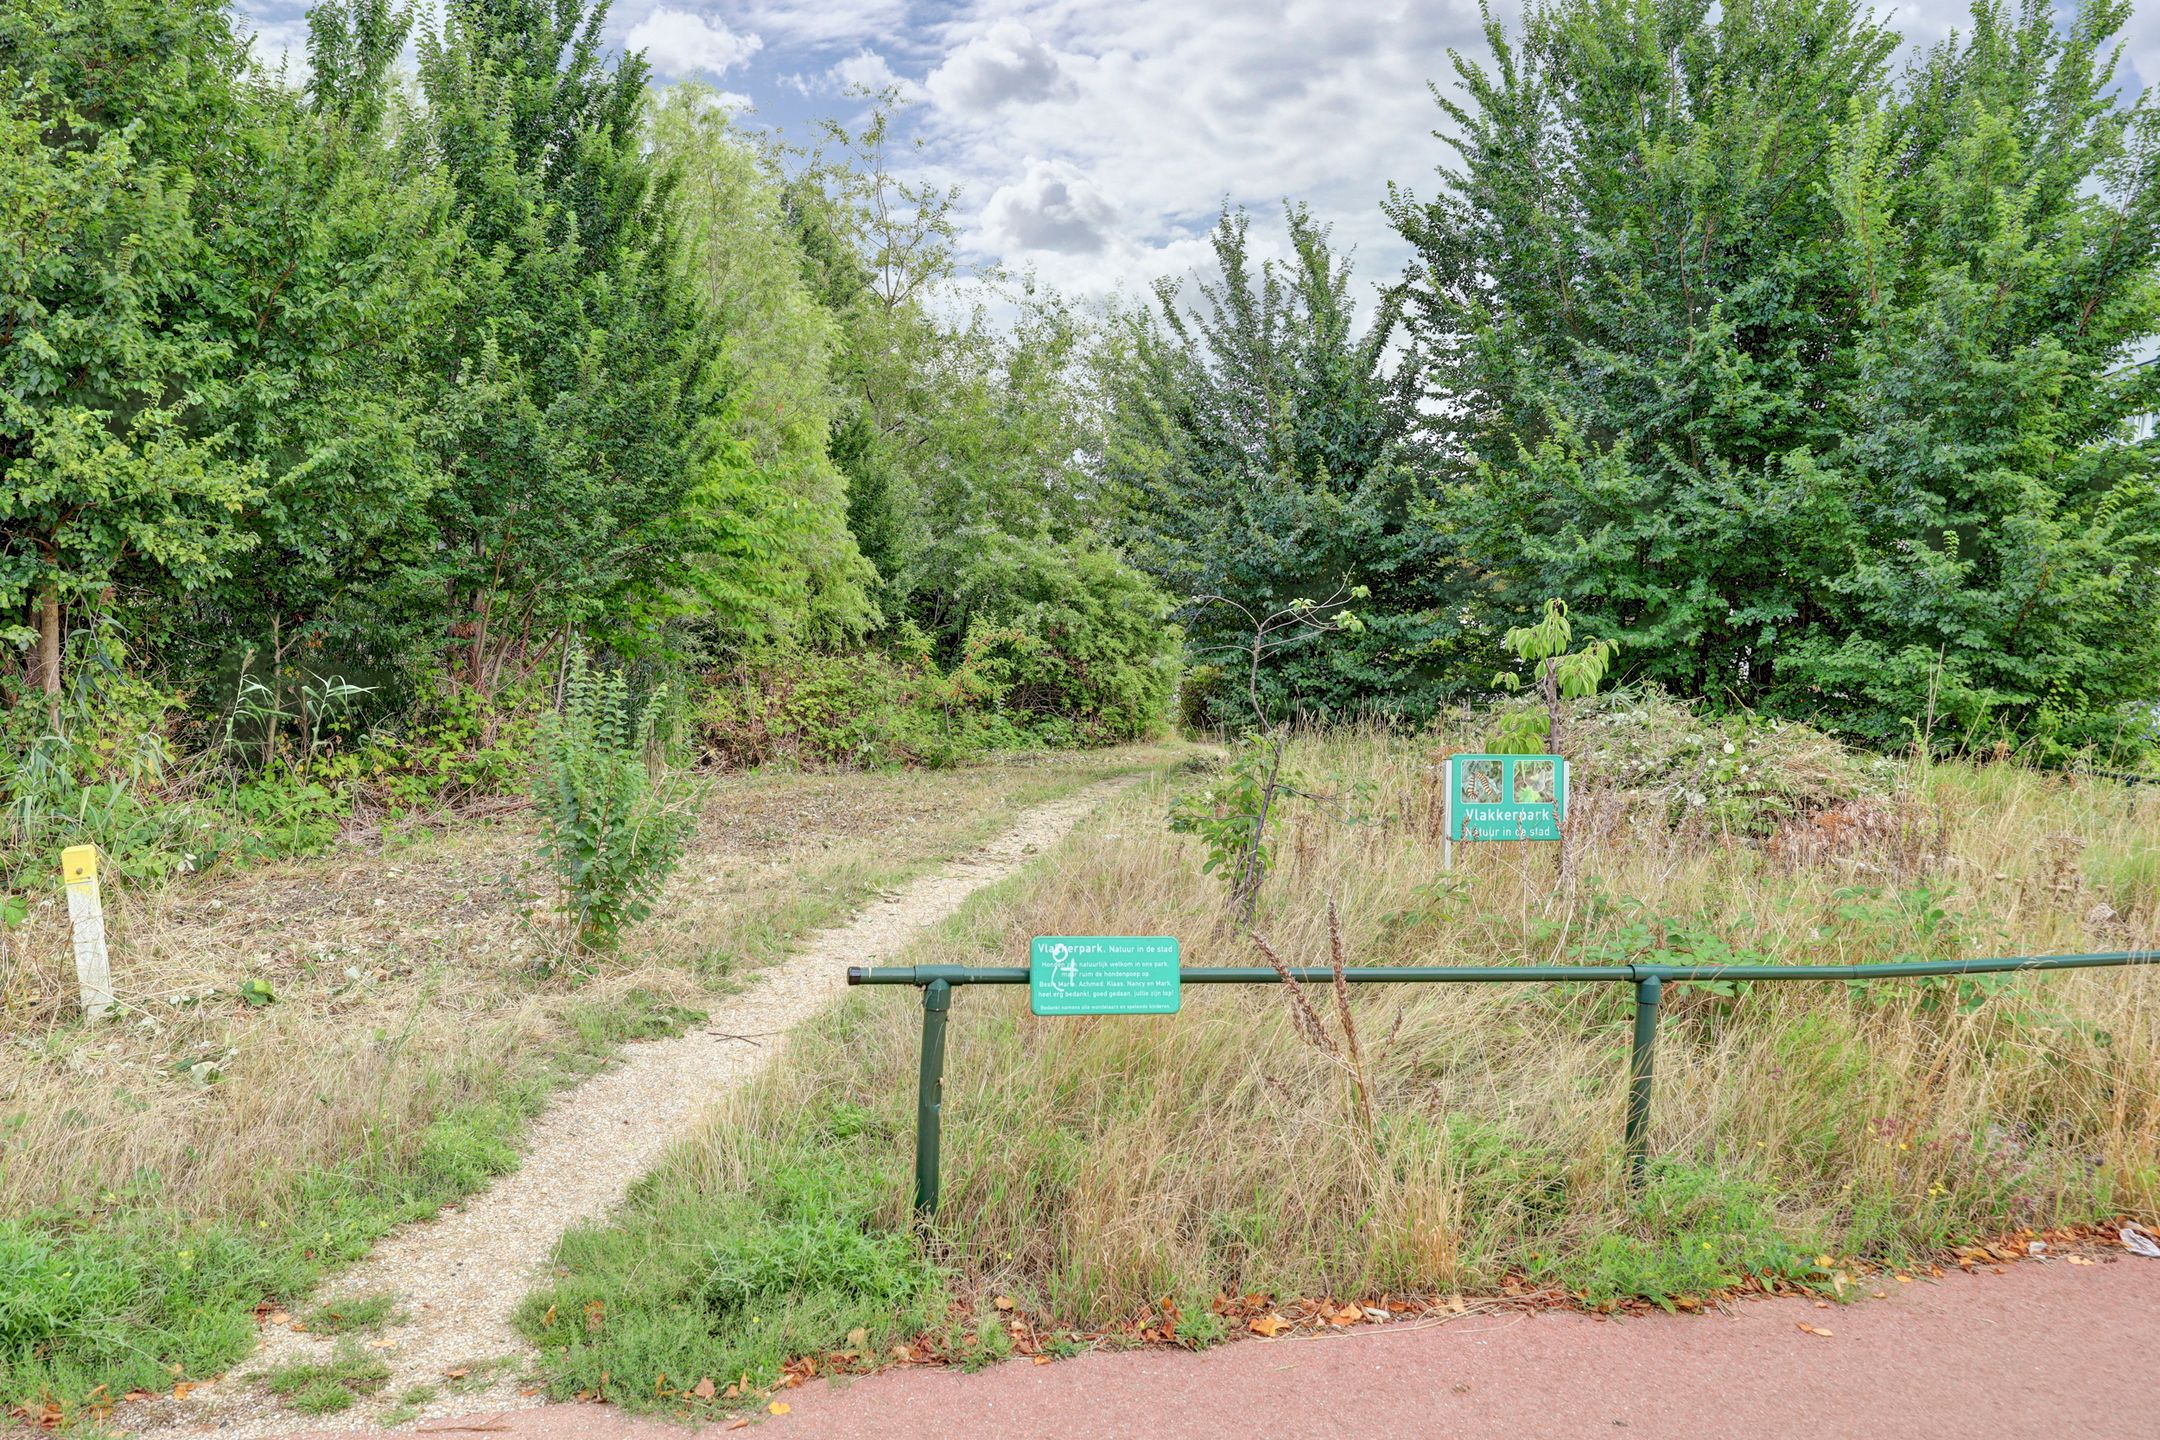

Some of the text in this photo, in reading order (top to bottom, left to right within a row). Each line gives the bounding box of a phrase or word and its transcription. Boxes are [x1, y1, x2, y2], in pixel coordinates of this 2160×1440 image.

[1465, 808, 1549, 821] Vlakkerpark
[1465, 826, 1499, 837] Ntuur
[1502, 826, 1512, 837] in
[1529, 826, 1550, 836] stad
[1038, 943, 1173, 955] Vlaerpark. Natuur in de stad
